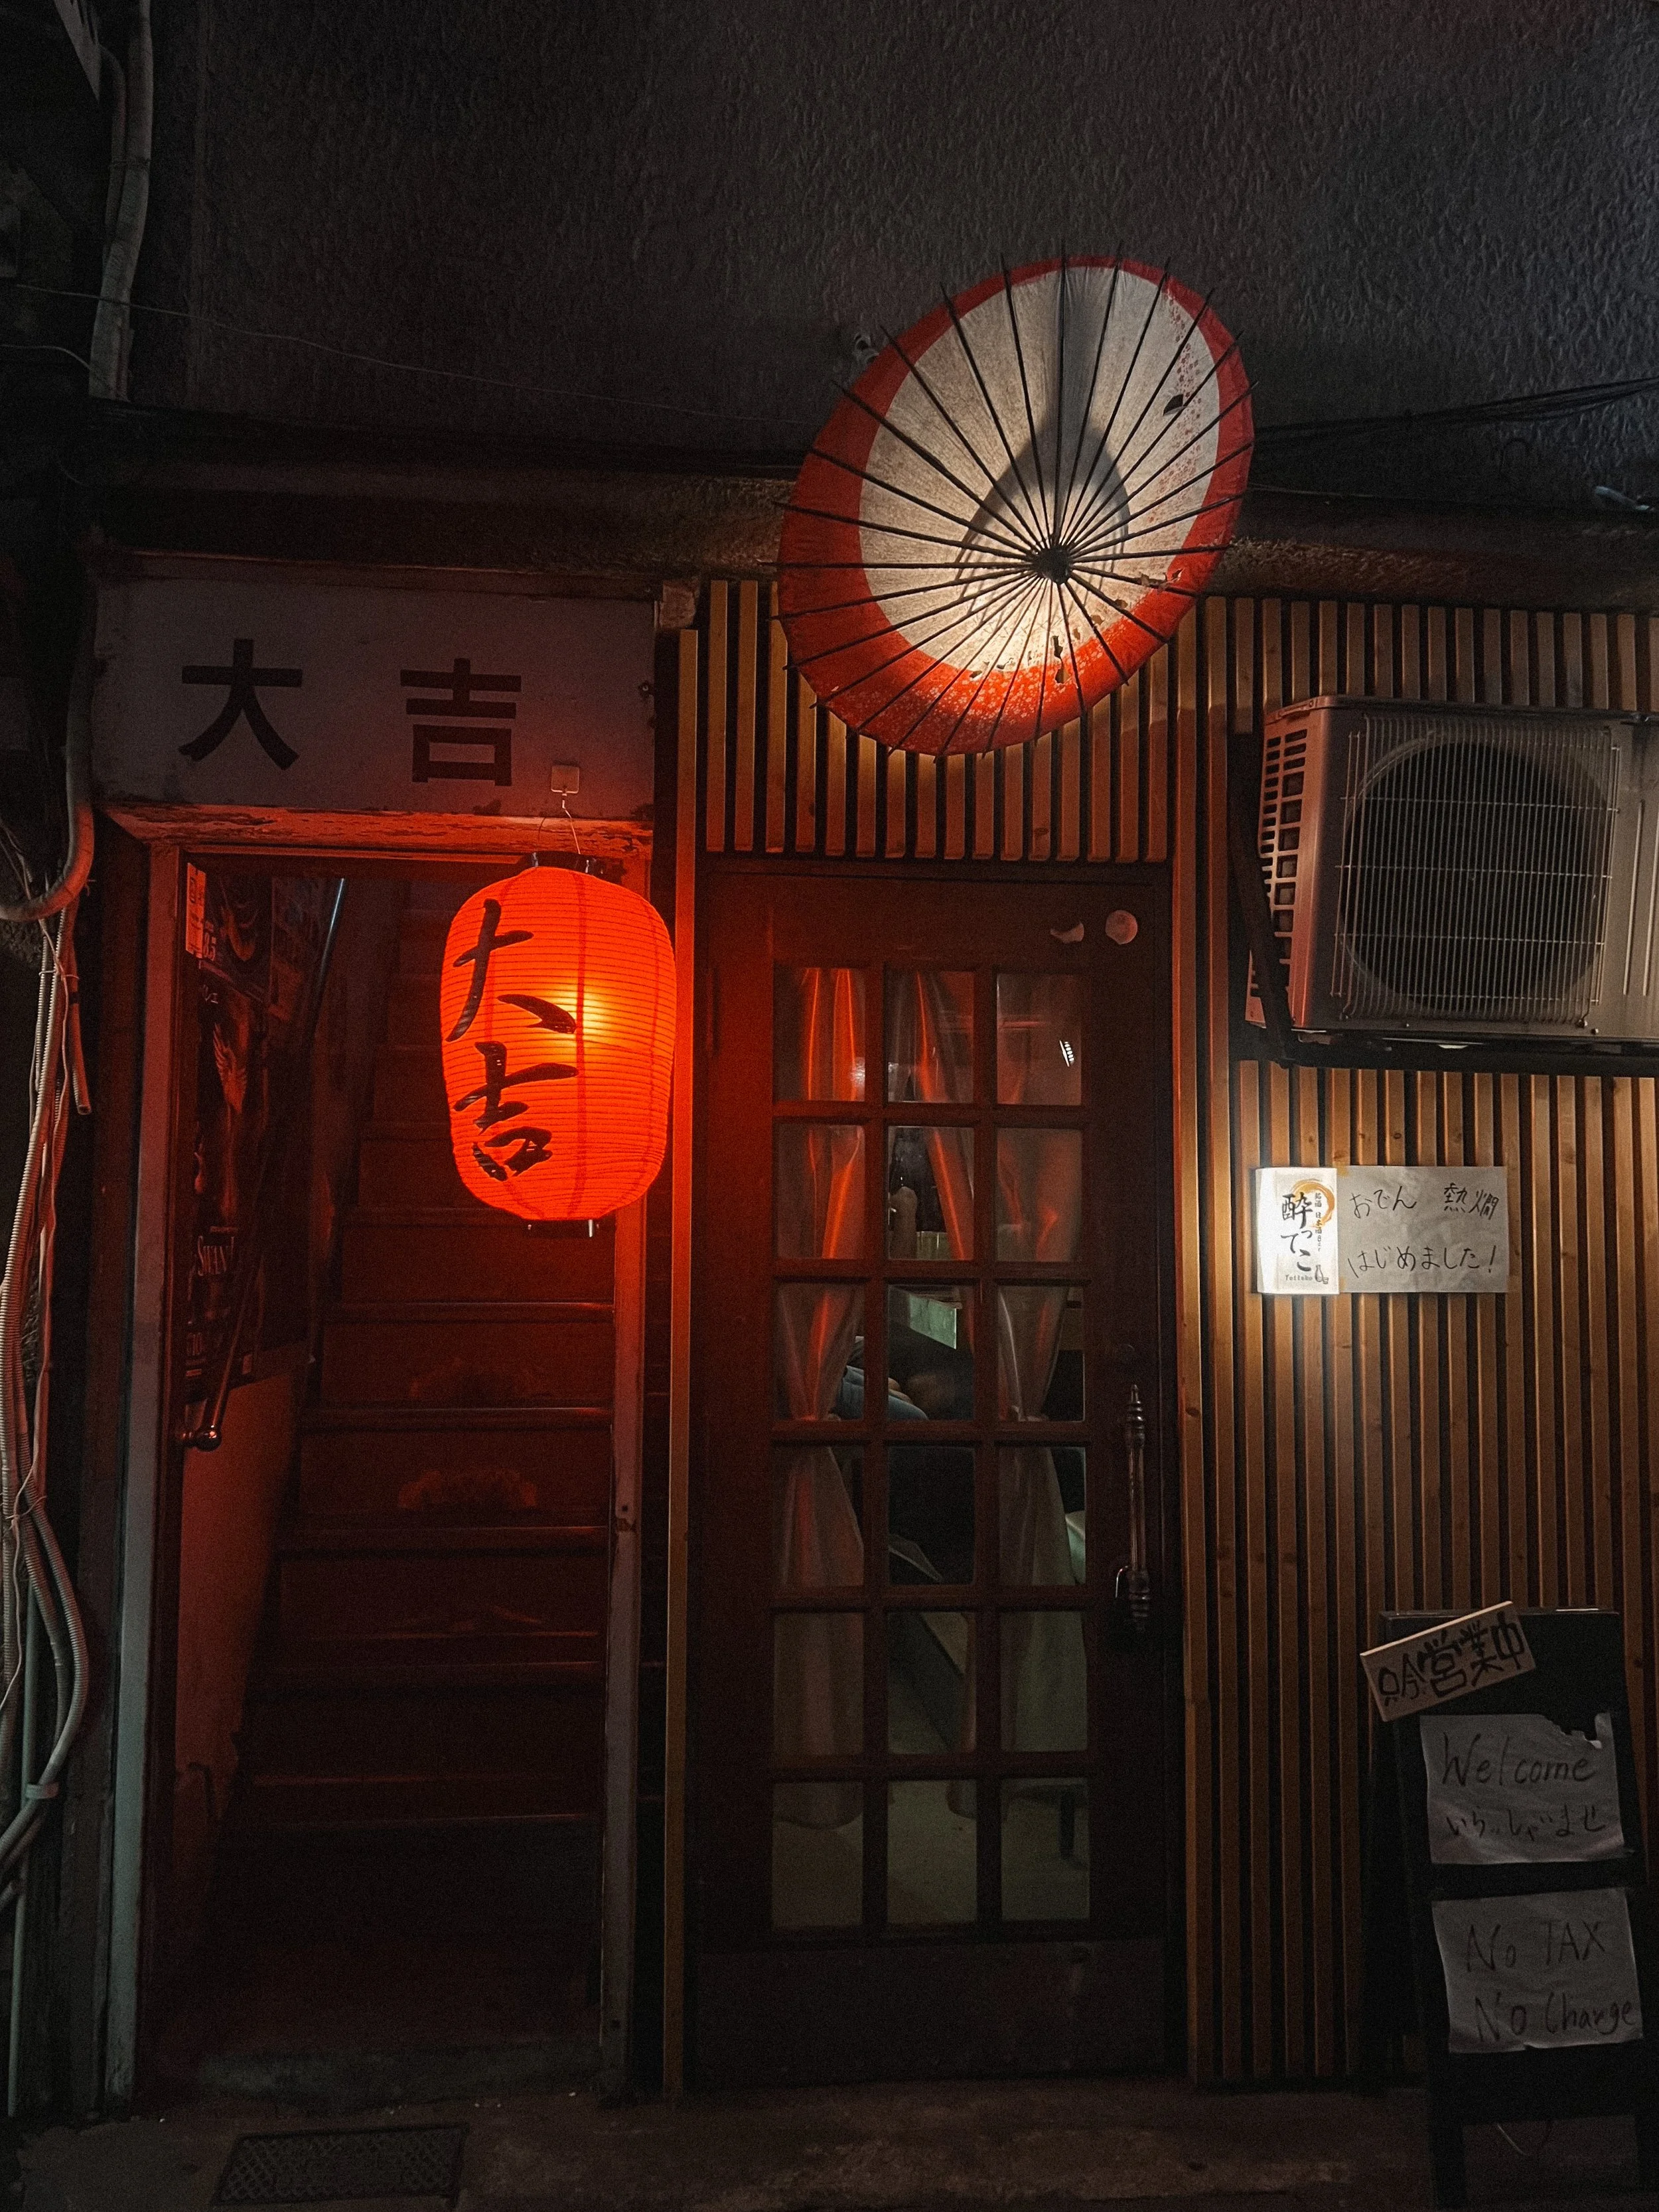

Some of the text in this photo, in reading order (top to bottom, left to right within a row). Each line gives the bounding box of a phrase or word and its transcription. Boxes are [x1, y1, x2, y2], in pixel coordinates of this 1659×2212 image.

[179, 638, 522, 787] 大吉
[445, 897, 580, 1182] 大吉
[1349, 1185, 1417, 1219] おでん
[1441, 1731, 1597, 1787] Welcome
[1466, 1919, 1606, 1973] No TAX
[1545, 1990, 1635, 2035] Charge
